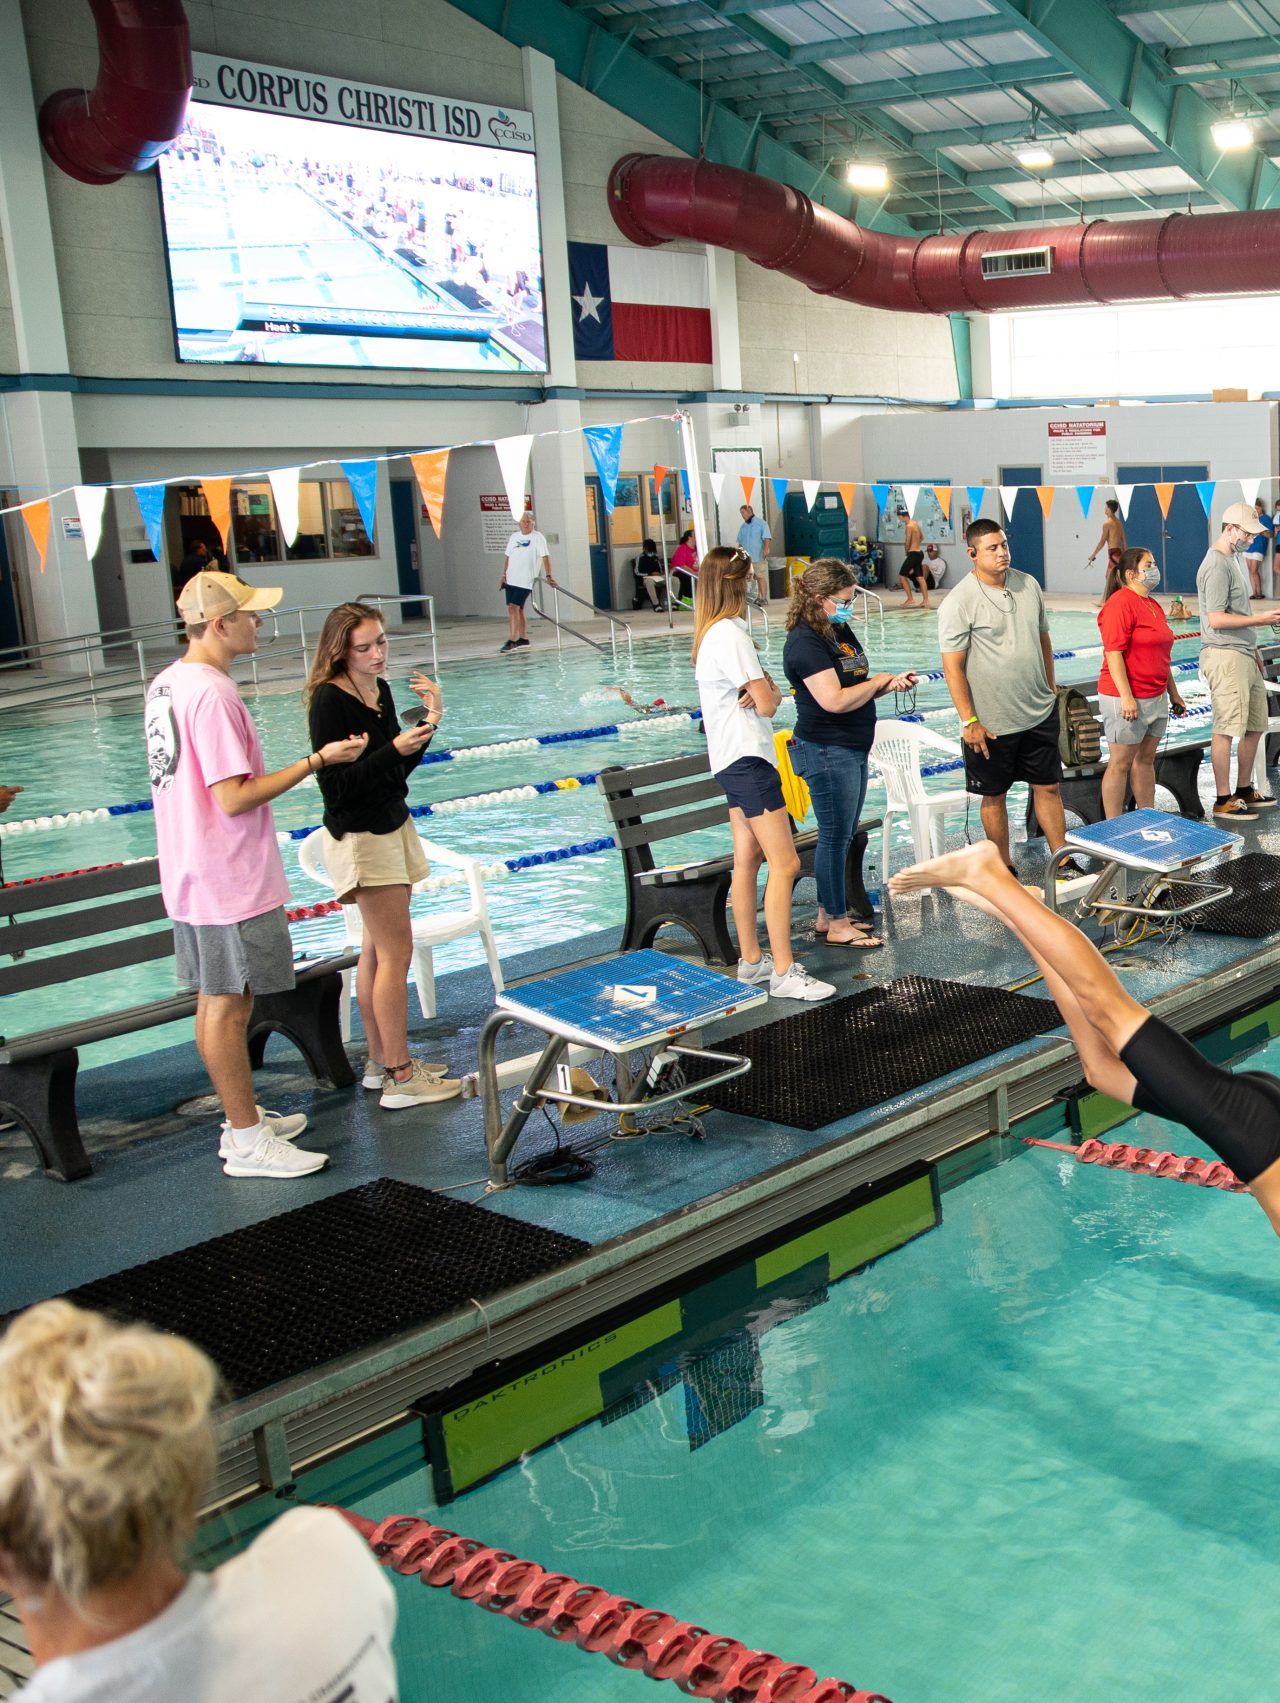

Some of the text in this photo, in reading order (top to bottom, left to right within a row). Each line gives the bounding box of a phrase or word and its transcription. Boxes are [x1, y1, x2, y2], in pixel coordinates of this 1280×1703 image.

[217, 64, 482, 139] CORPUS CHRISTI ISD
[495, 128, 532, 142] CCISD
[264, 321, 301, 333] Heat 3
[1110, 886, 1118, 900] 2
[560, 1064, 567, 1091] 1
[453, 1332, 617, 1421] DAKTRONICS
